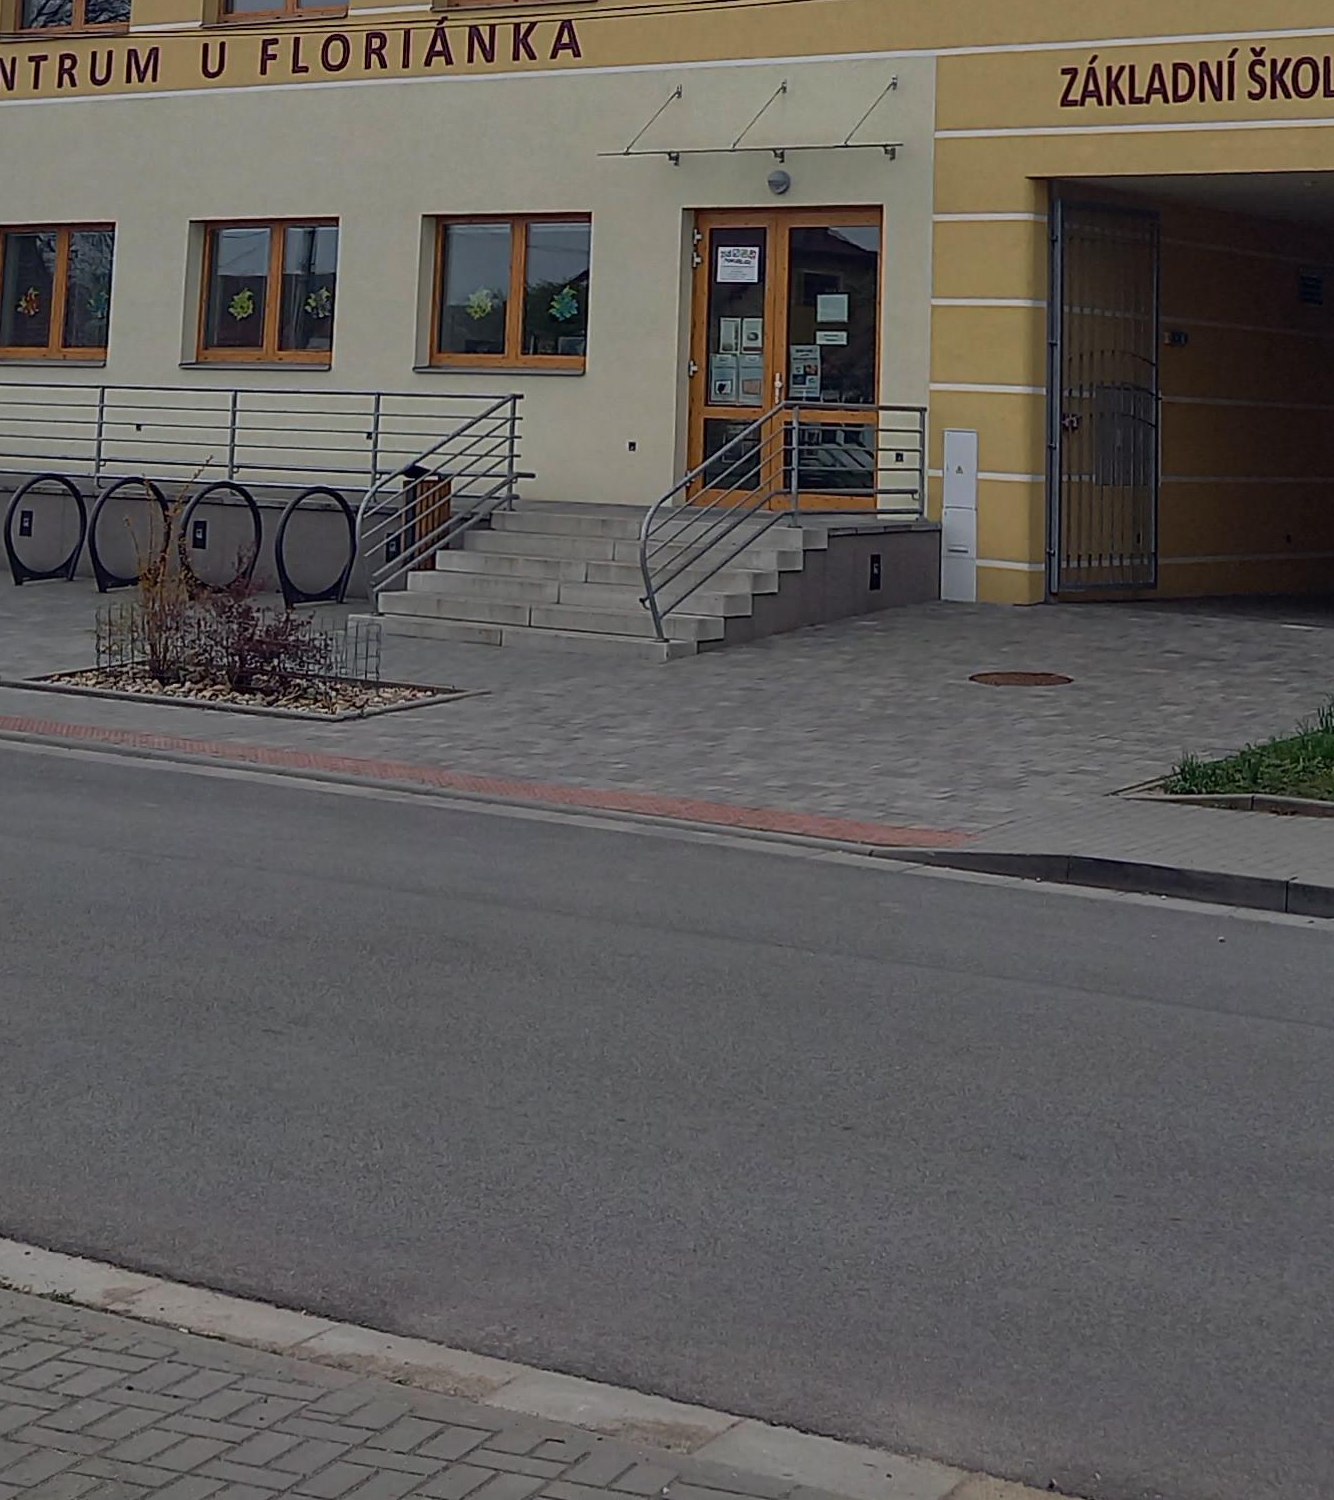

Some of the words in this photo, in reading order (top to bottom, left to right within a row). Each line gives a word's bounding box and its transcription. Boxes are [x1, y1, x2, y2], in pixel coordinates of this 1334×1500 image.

[201, 41, 227, 79] U
[259, 15, 582, 76] FLORIÁNKA
[1059, 47, 1239, 107] ZÁKLADNÍ
